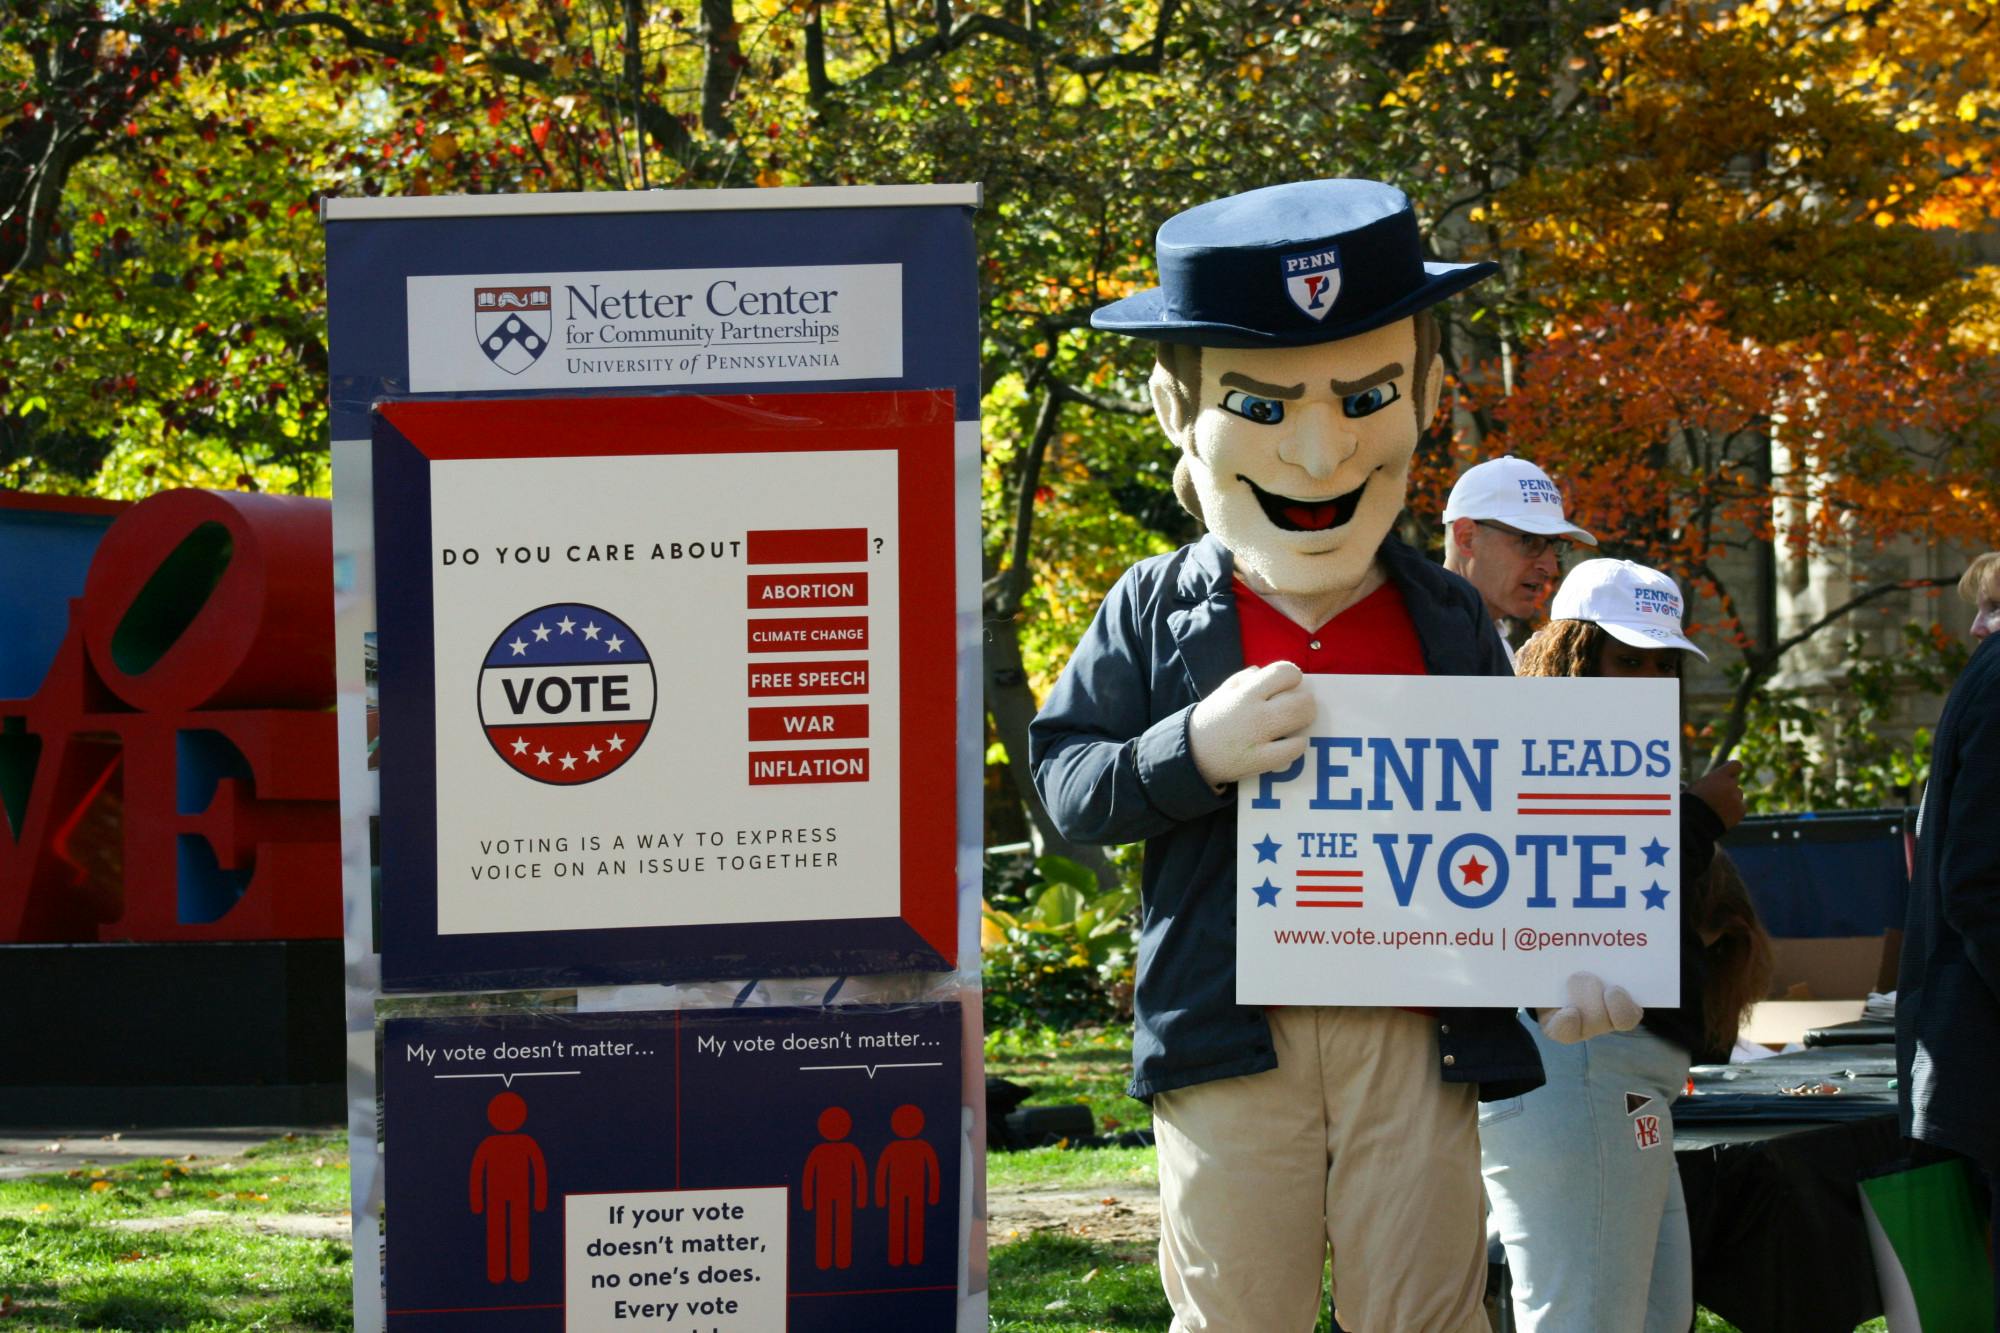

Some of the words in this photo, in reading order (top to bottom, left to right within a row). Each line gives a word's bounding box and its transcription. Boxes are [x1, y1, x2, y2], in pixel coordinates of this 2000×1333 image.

[1287, 251, 1336, 272] PENN
[565, 285, 692, 320] Netter
[707, 281, 838, 316] Center
[566, 324, 593, 344] for
[600, 323, 715, 348] Community
[720, 319, 839, 344] Partnerships
[567, 359, 672, 373] UNIVERSITY
[680, 355, 701, 374] of
[707, 354, 839, 369] PENNSYLVANIA
[443, 549, 479, 565] DO
[496, 547, 549, 563] YOU
[567, 544, 634, 562] CARE
[652, 542, 740, 559] ABOUT
[762, 584, 853, 599] ABORTION
[1635, 588, 1668, 602] PENN
[753, 631, 806, 641] CLIMATE
[811, 629, 863, 640] CHANGE
[752, 674, 791, 688] FREE
[799, 671, 864, 686] SPEECH
[502, 675, 630, 714] VOTE
[784, 716, 833, 732] WAR
[755, 759, 863, 777] INFLATION
[1252, 737, 1499, 811] PENN
[1522, 739, 1671, 777] LEADS
[481, 838, 567, 854] VOTING
[582, 837, 600, 850] IS
[613, 836, 624, 849] A
[637, 834, 683, 848] WAY
[696, 832, 723, 846] TO
[738, 828, 836, 845] EXPRESS
[472, 864, 540, 880] VOICE
[555, 863, 583, 877] ON
[598, 861, 625, 875] AN
[640, 858, 704, 873] ISSUE
[717, 853, 837, 870] TOGETHER
[1298, 833, 1357, 857] THE
[1373, 833, 1626, 909] VOTE
[1275, 928, 1493, 949] www.vote.upenn.edu
[1515, 928, 1647, 951] @pennvotes
[408, 1044, 436, 1066] My
[443, 1045, 485, 1060] vote
[494, 1041, 563, 1059] doesn't
[572, 1041, 653, 1056] matter...
[699, 1036, 726, 1056] My
[734, 1036, 774, 1051] vote
[783, 1032, 851, 1050] doesn't
[859, 1032, 939, 1047] matter...
[610, 1206, 624, 1224] If
[632, 1208, 684, 1228] your
[693, 1203, 743, 1220] vote
[587, 1236, 673, 1257] doesn't
[682, 1234, 765, 1252] matter,
[592, 1274, 620, 1288] no
[629, 1267, 689, 1286] one's
[698, 1266, 760, 1283] does.
[615, 1301, 678, 1321] Every
[687, 1297, 737, 1315] vote
